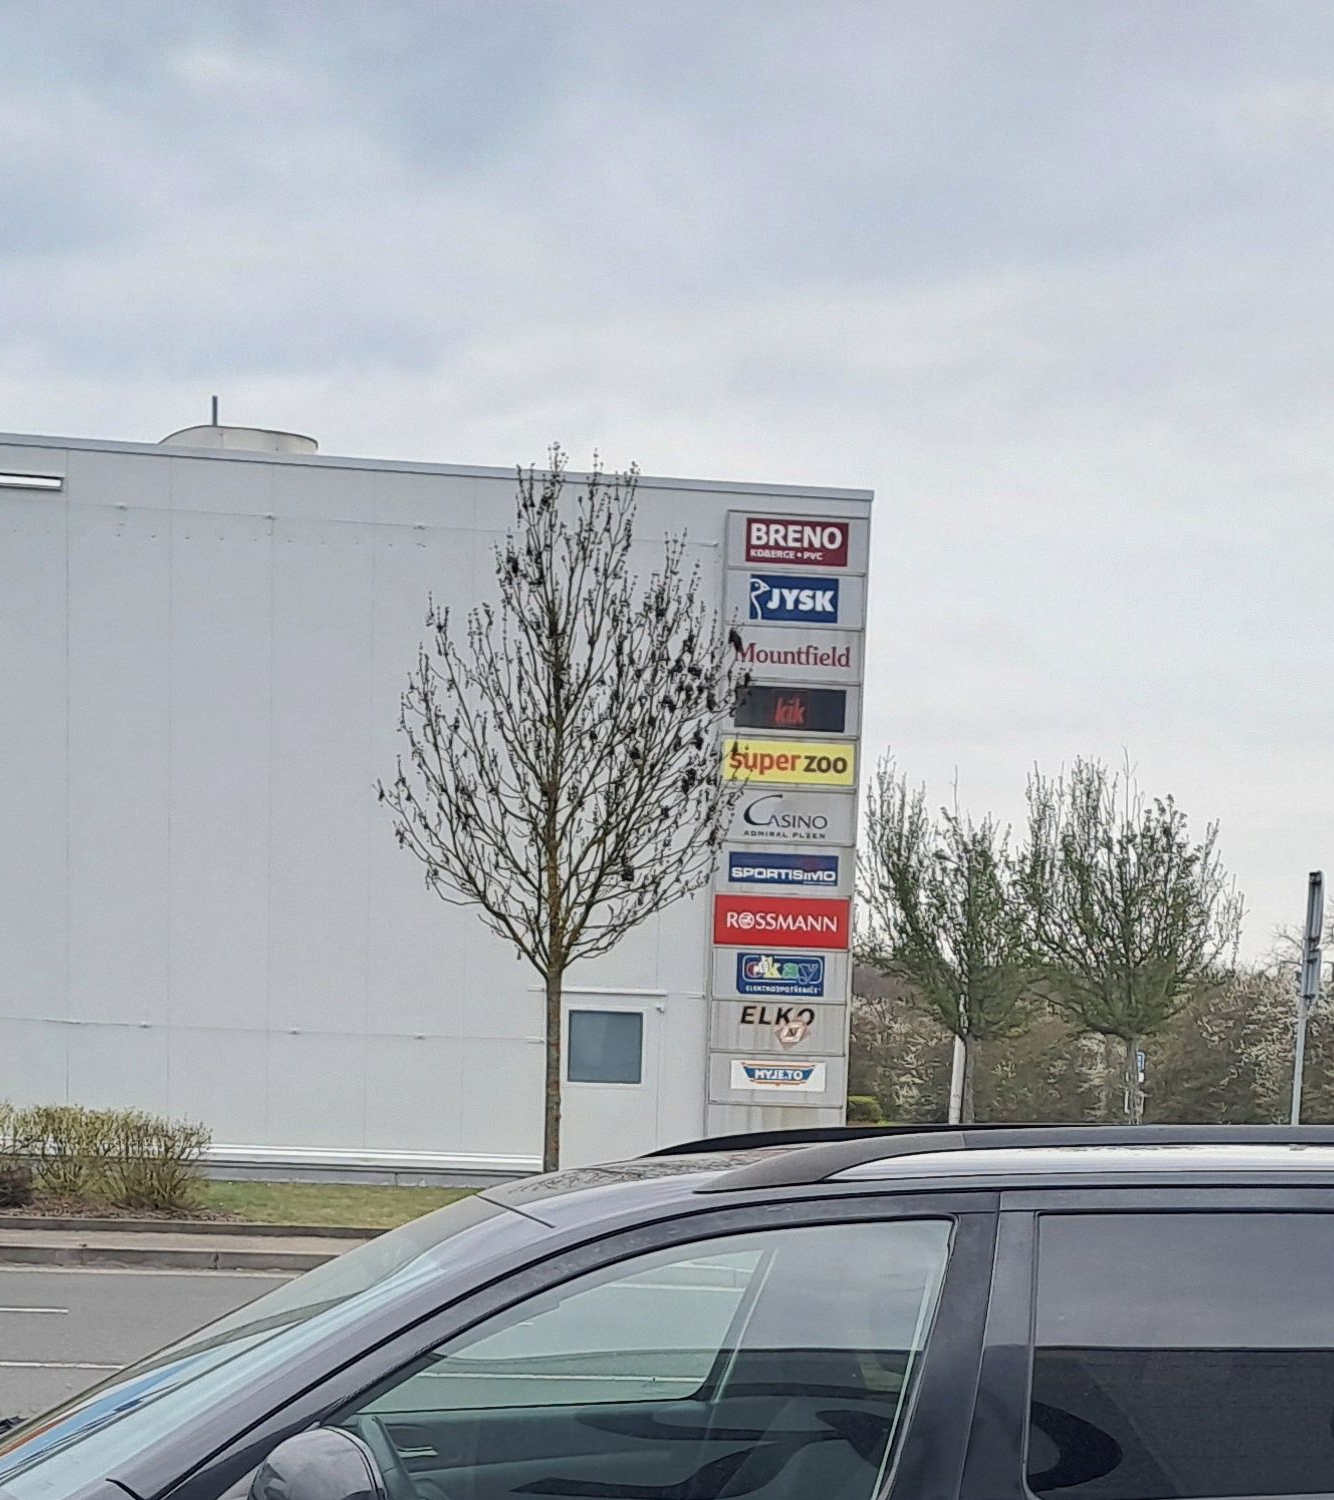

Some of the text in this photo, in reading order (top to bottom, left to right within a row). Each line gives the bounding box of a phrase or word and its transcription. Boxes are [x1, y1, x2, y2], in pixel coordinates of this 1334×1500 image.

[750, 522, 843, 549] BRENO
[803, 551, 824, 560] PVC
[766, 588, 835, 612] JYSK
[736, 642, 851, 668] Mountfield
[729, 750, 848, 776] super zoo
[743, 794, 829, 830] CASINO
[743, 829, 788, 839] ADMIRAL
[726, 911, 838, 933] ROSSMANN
[740, 1005, 816, 1026] ELKO
